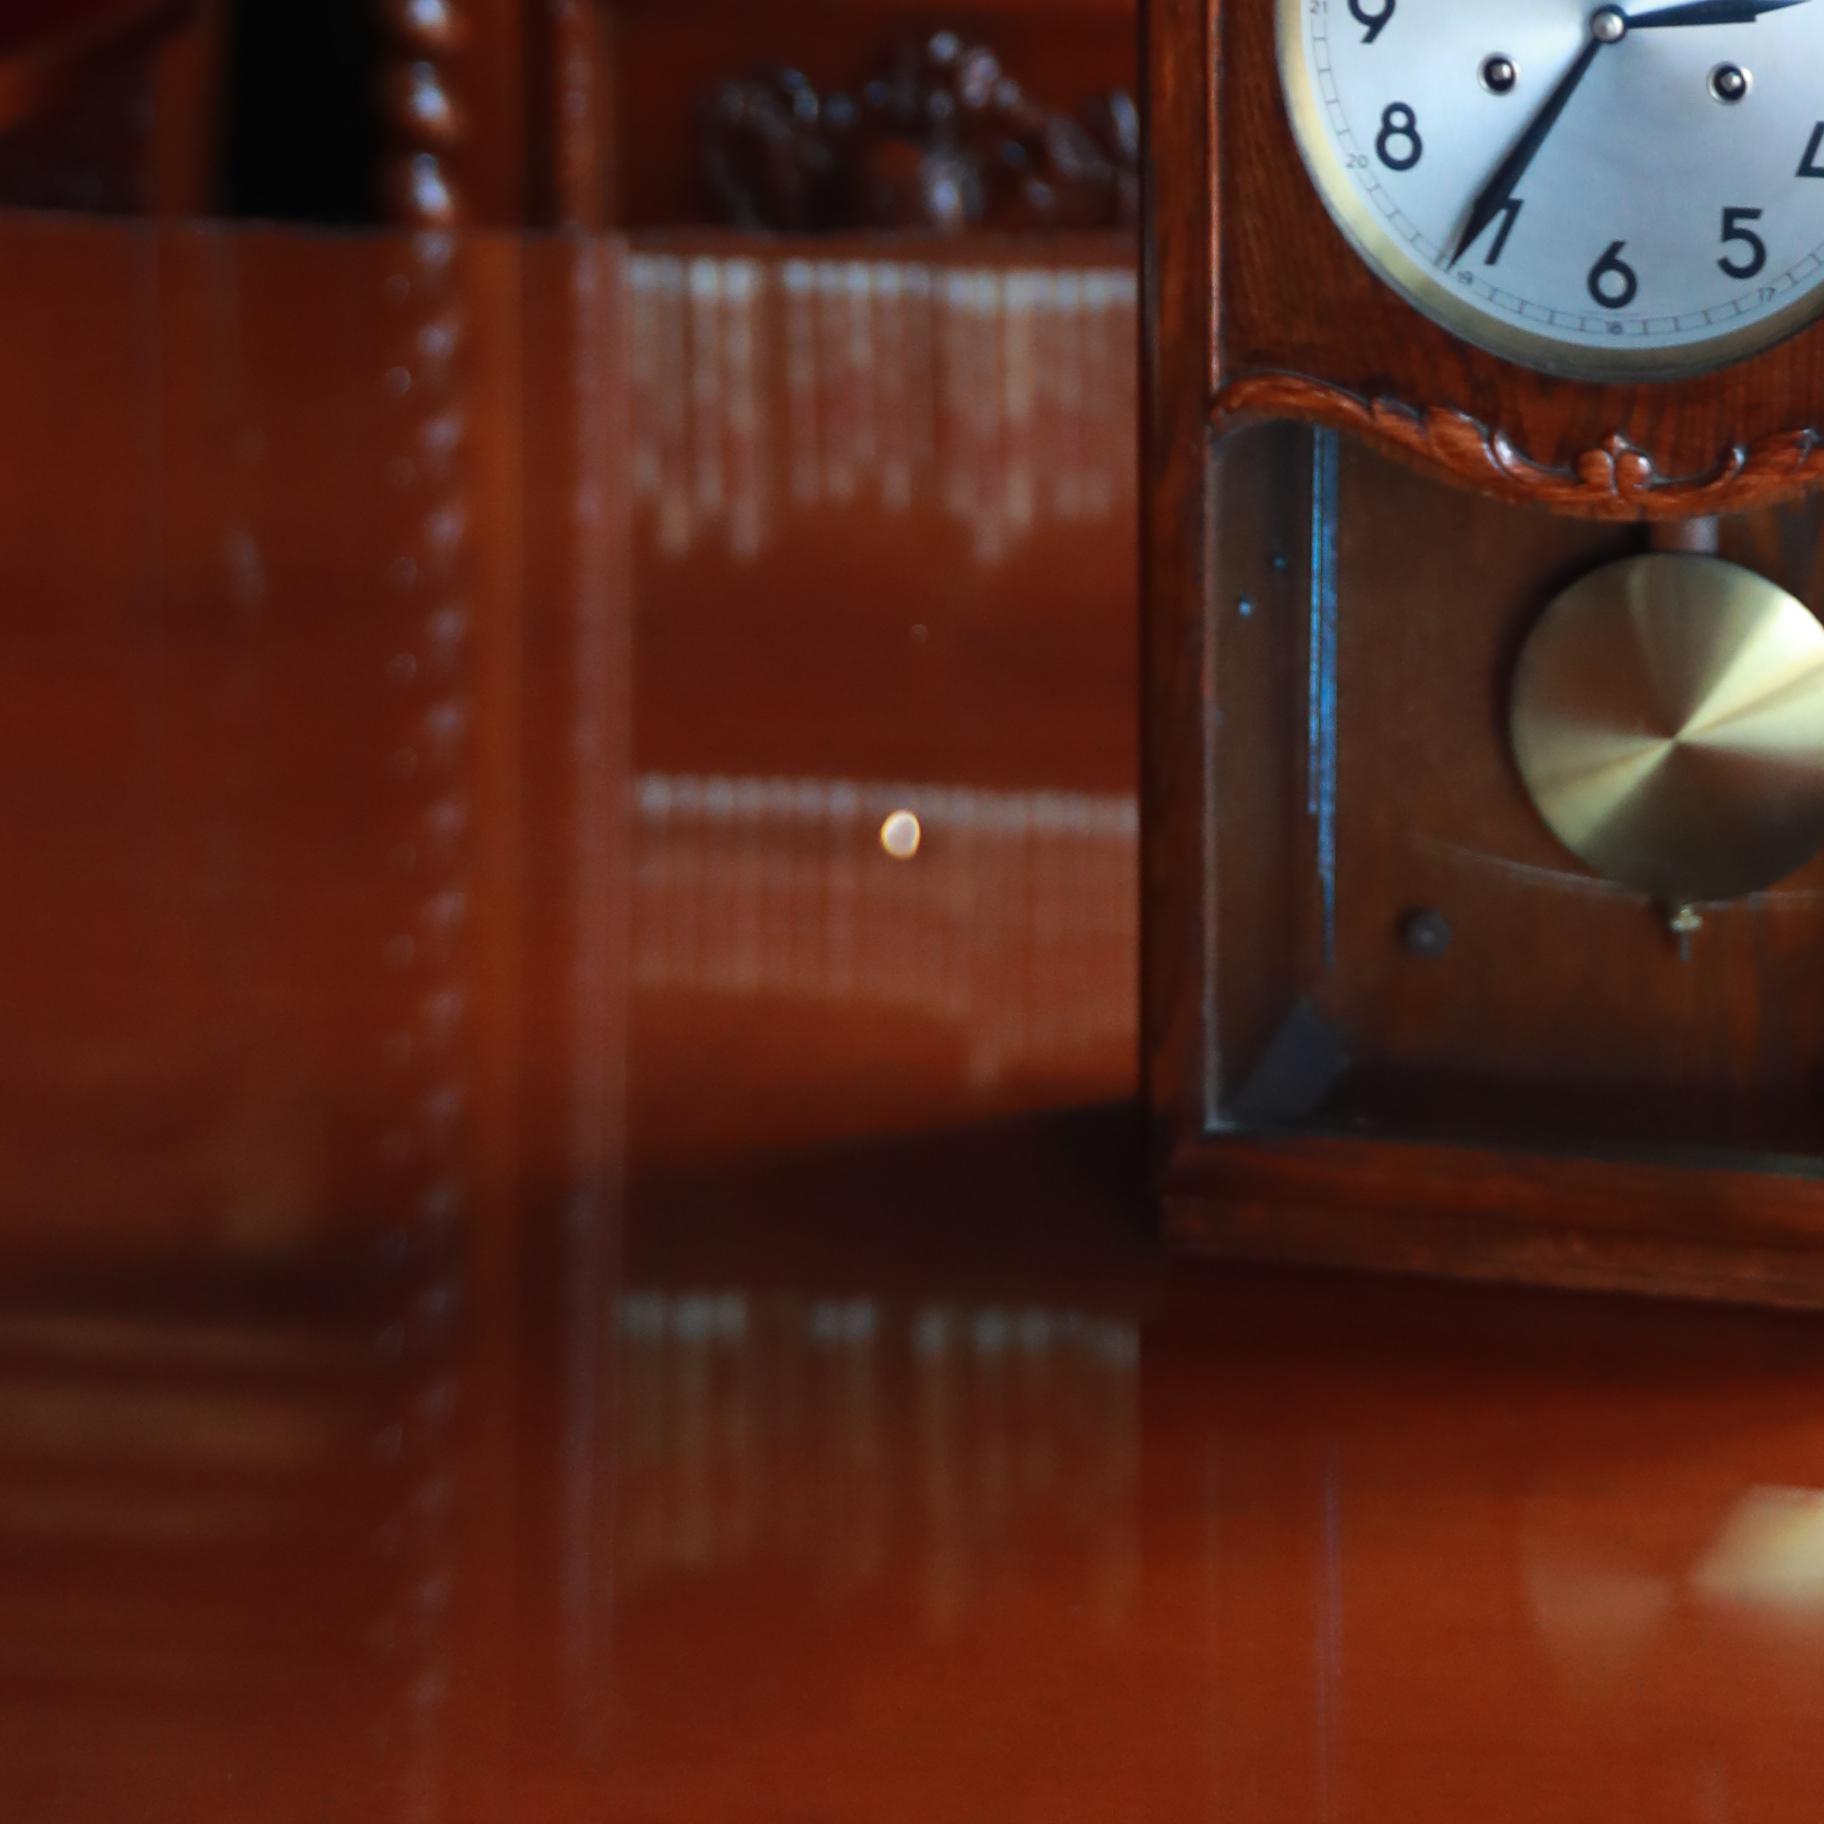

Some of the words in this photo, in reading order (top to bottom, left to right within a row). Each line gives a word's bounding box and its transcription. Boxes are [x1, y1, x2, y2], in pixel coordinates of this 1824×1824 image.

[1310, 0, 1327, 13] 21
[1347, 155, 1368, 168] 20
[1375, 102, 1423, 171] 8
[1482, 198, 1524, 266] 7
[1717, 207, 1766, 279] 5
[1587, 241, 1637, 309] 6
[1759, 288, 1776, 302] 17
